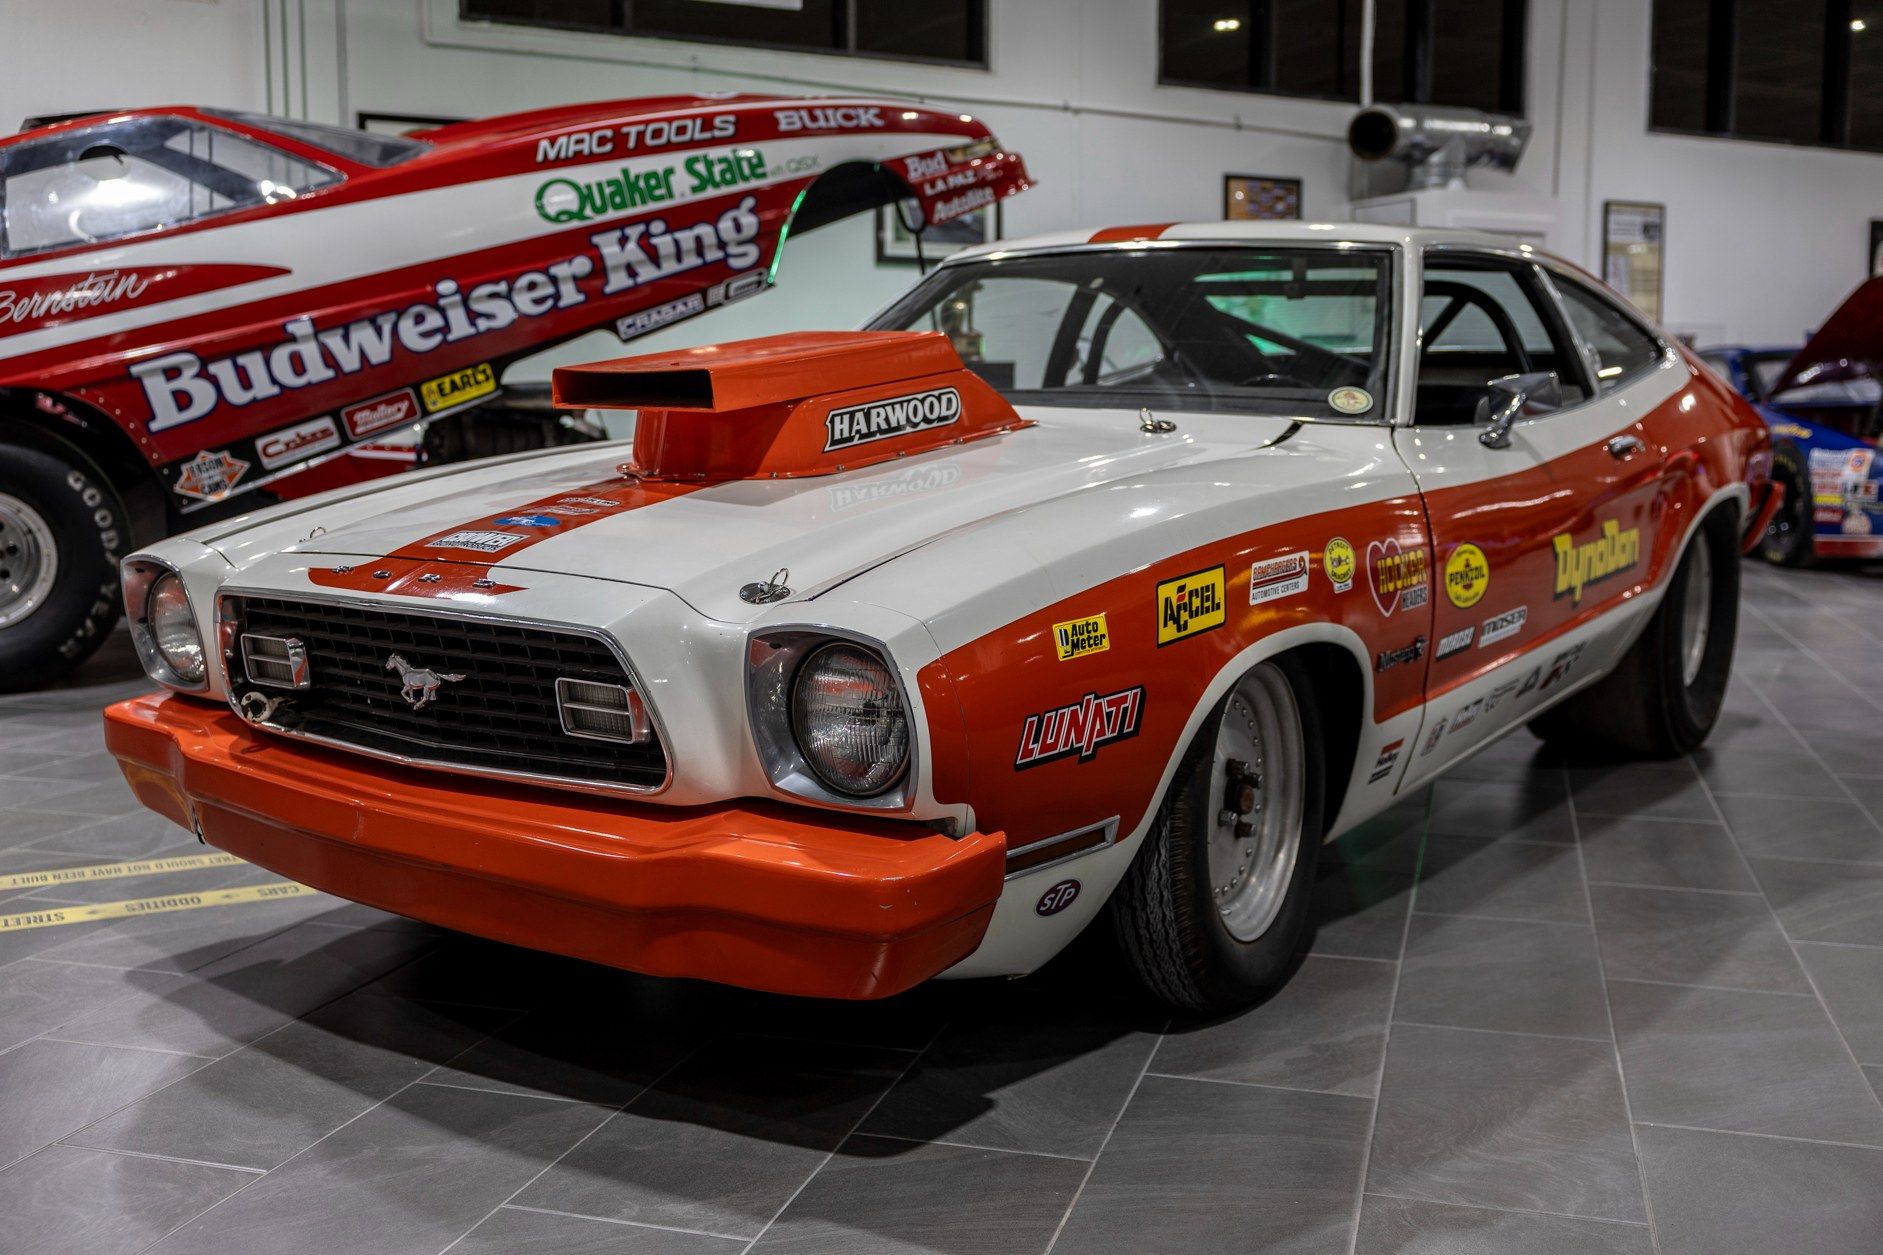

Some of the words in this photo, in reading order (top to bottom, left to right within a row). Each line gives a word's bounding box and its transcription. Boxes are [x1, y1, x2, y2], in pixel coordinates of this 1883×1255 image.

[774, 107, 884, 132] BUICK
[536, 129, 613, 163] MAC
[621, 115, 736, 149] TOOLS
[904, 150, 948, 181] Bud
[535, 166, 676, 224] Quaker
[684, 149, 768, 195] State
[924, 181, 947, 197] LA
[129, 252, 594, 434] Budweiser
[588, 196, 760, 298] King
[622, 301, 703, 337] CRAGAR
[437, 365, 491, 397] EARL'S
[832, 393, 958, 441] HARWOOD
[1377, 549, 1427, 594] HOOKER
[1449, 565, 1486, 588] PENNZOIL
[1281, 581, 1300, 594] CENTERS
[1163, 582, 1221, 633] ACCEL
[1071, 620, 1099, 638] Auto
[1070, 633, 1106, 653] Meter
[1015, 685, 1145, 770] LUNATI
[12, 873, 49, 886] BUILT
[52, 870, 86, 882] BEEN
[91, 866, 122, 879] HAVE
[125, 864, 145, 874] NOT
[256, 885, 301, 899] CARS
[1040, 883, 1076, 912] STP
[124, 895, 202, 914] ODDITIES
[2, 910, 66, 929] STREET
